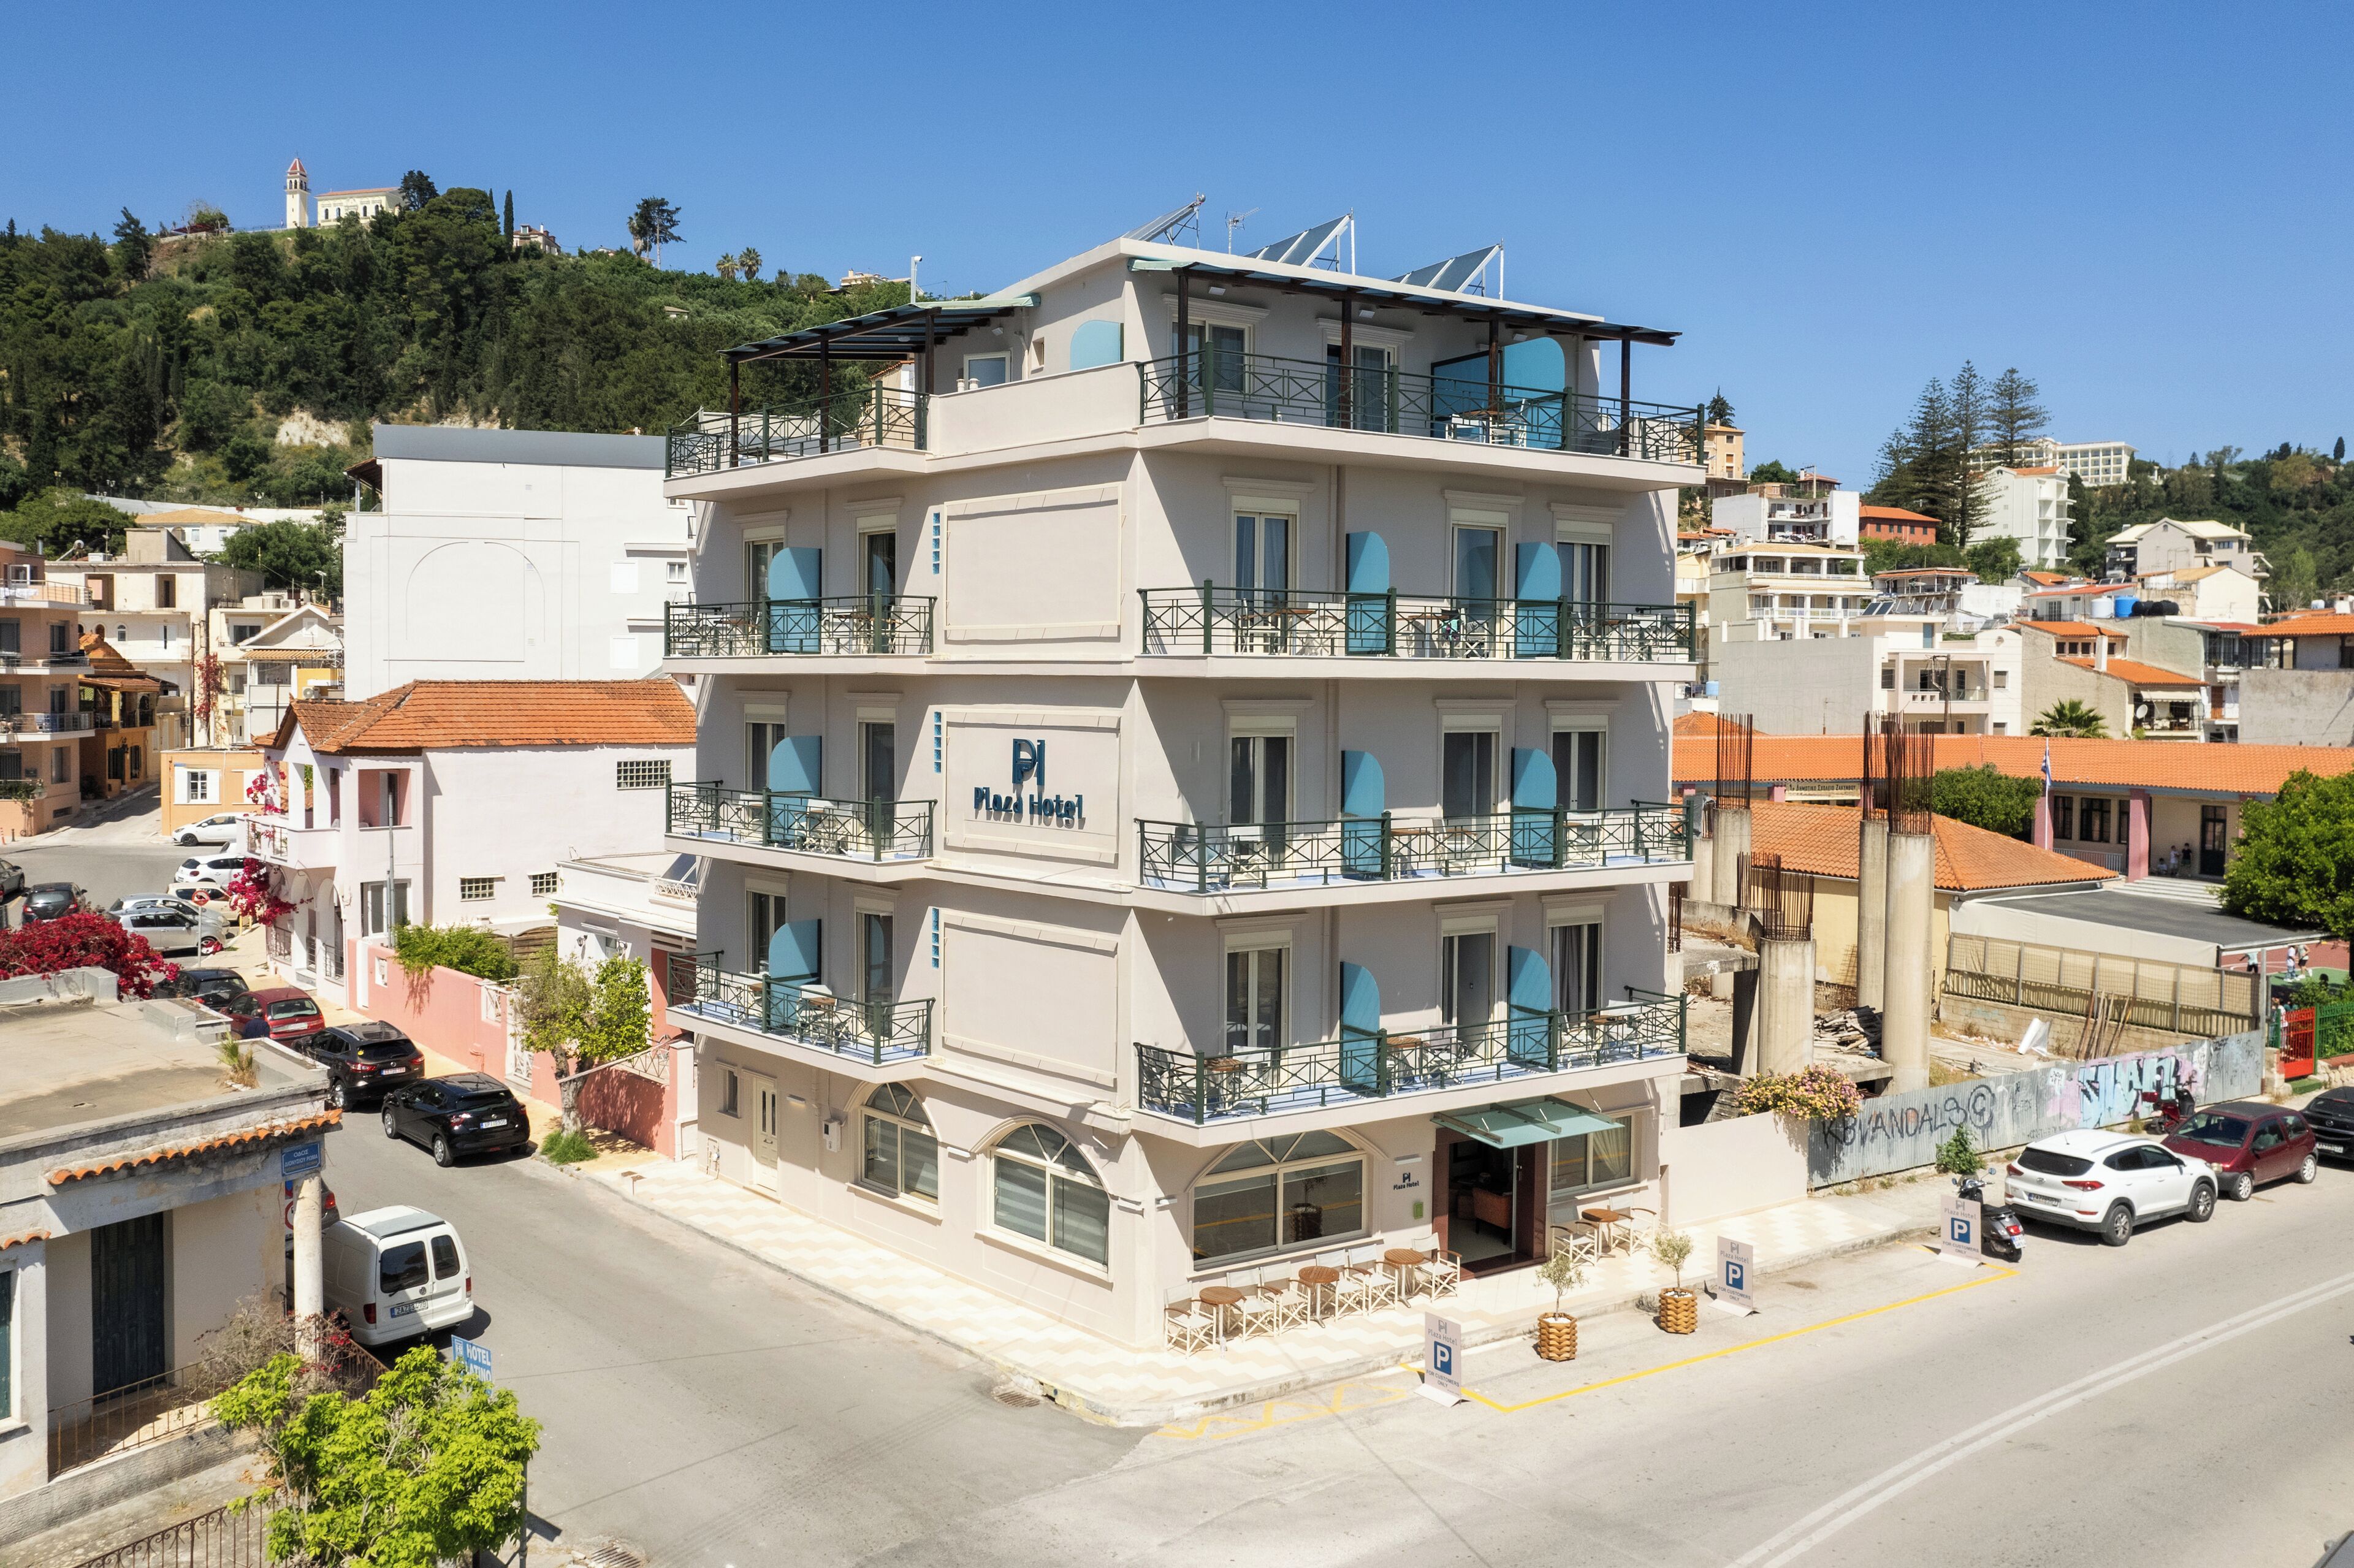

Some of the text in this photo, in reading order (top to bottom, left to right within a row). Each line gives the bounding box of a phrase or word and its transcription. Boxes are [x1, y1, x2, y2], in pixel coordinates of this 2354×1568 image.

[974, 787, 1083, 819] Plaza Hotel
[1944, 1208, 1959, 1216] Plaza
[1954, 1220, 1968, 1239] P
[1720, 1250, 1750, 1264] Plaza Hotel
[1952, 1243, 1979, 1253] CUSTOMERS
[1729, 1264, 1741, 1285] P
[1727, 1288, 1751, 1300] CUSTOMERS
[1428, 1328, 1458, 1346] Plaza Hotel
[466, 1343, 491, 1366] HOTEL
[1436, 1344, 1450, 1368] P
[1435, 1373, 1460, 1387] CUSTOMERS
